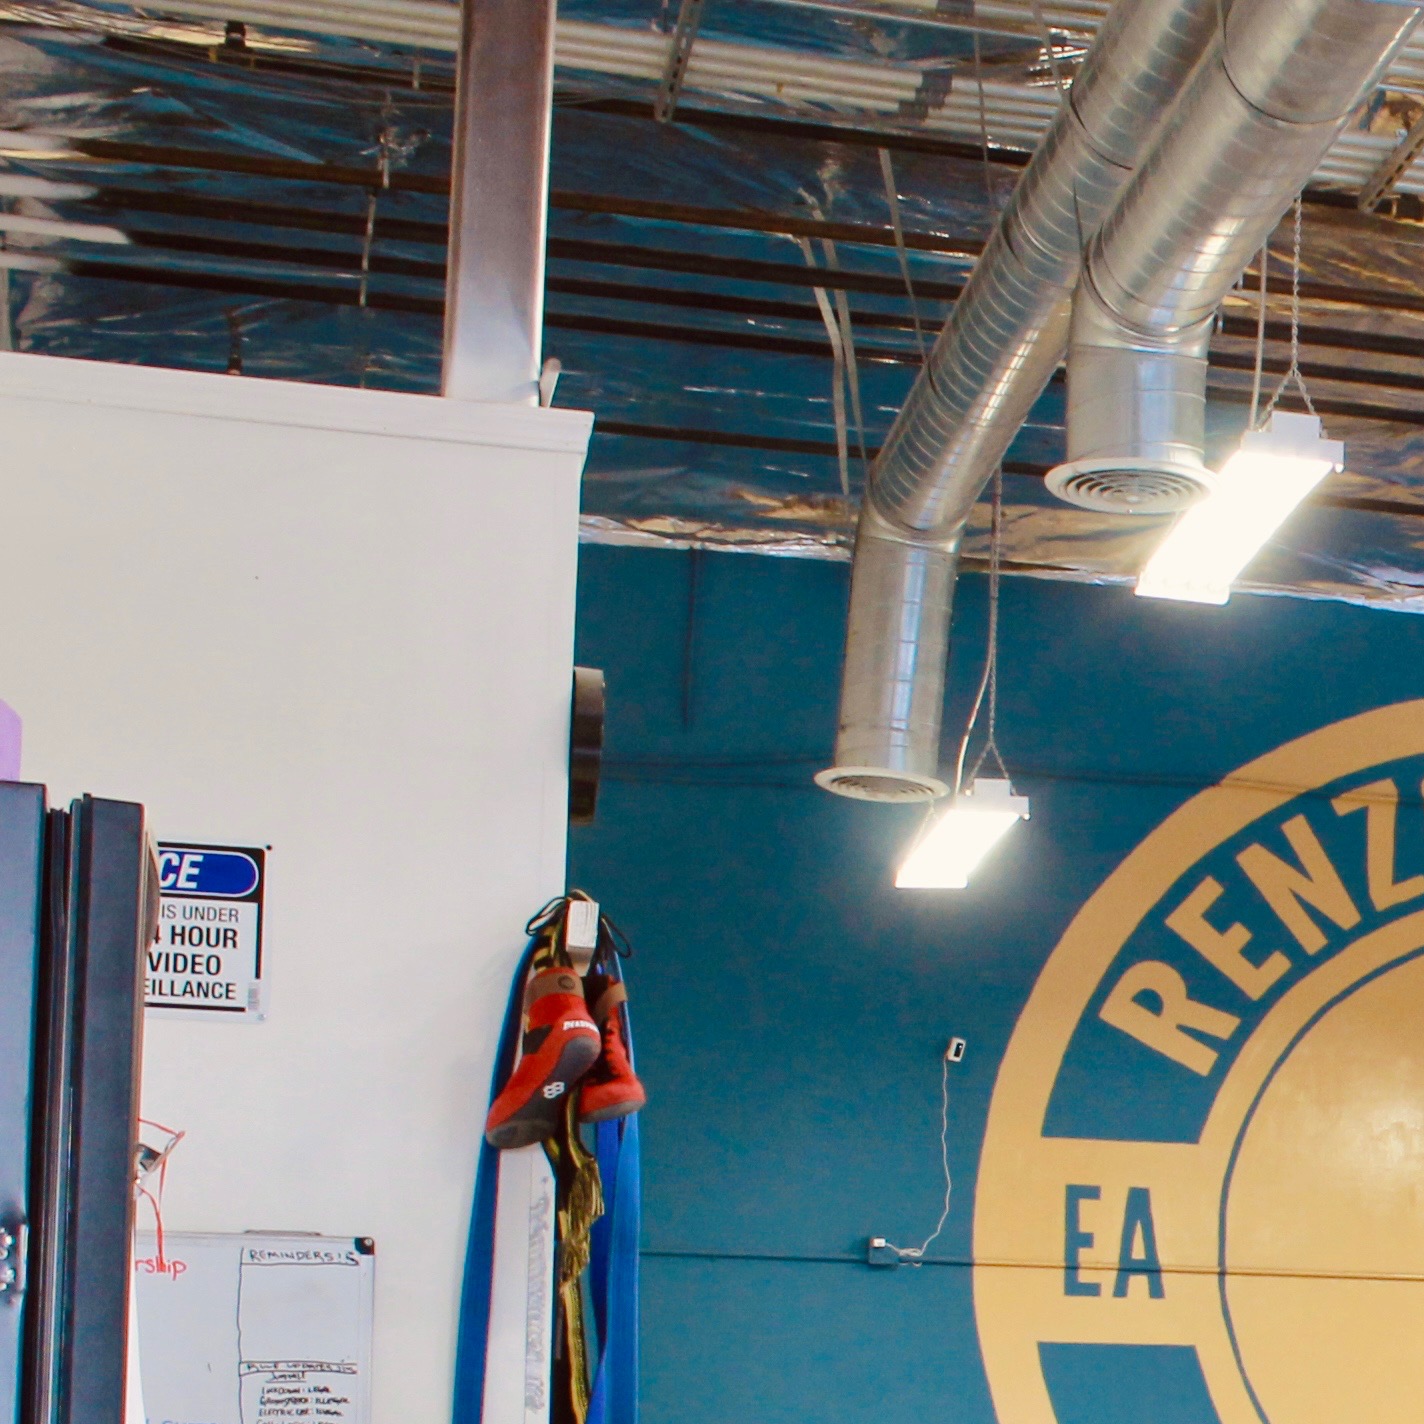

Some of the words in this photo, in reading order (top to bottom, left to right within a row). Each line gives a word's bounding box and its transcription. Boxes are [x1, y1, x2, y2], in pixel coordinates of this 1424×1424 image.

[161, 904, 177, 919] IS
[182, 905, 239, 923] UNDER
[170, 925, 238, 949] HOUR
[148, 952, 221, 976] VIDEO
[144, 978, 237, 1000] EILLANCE
